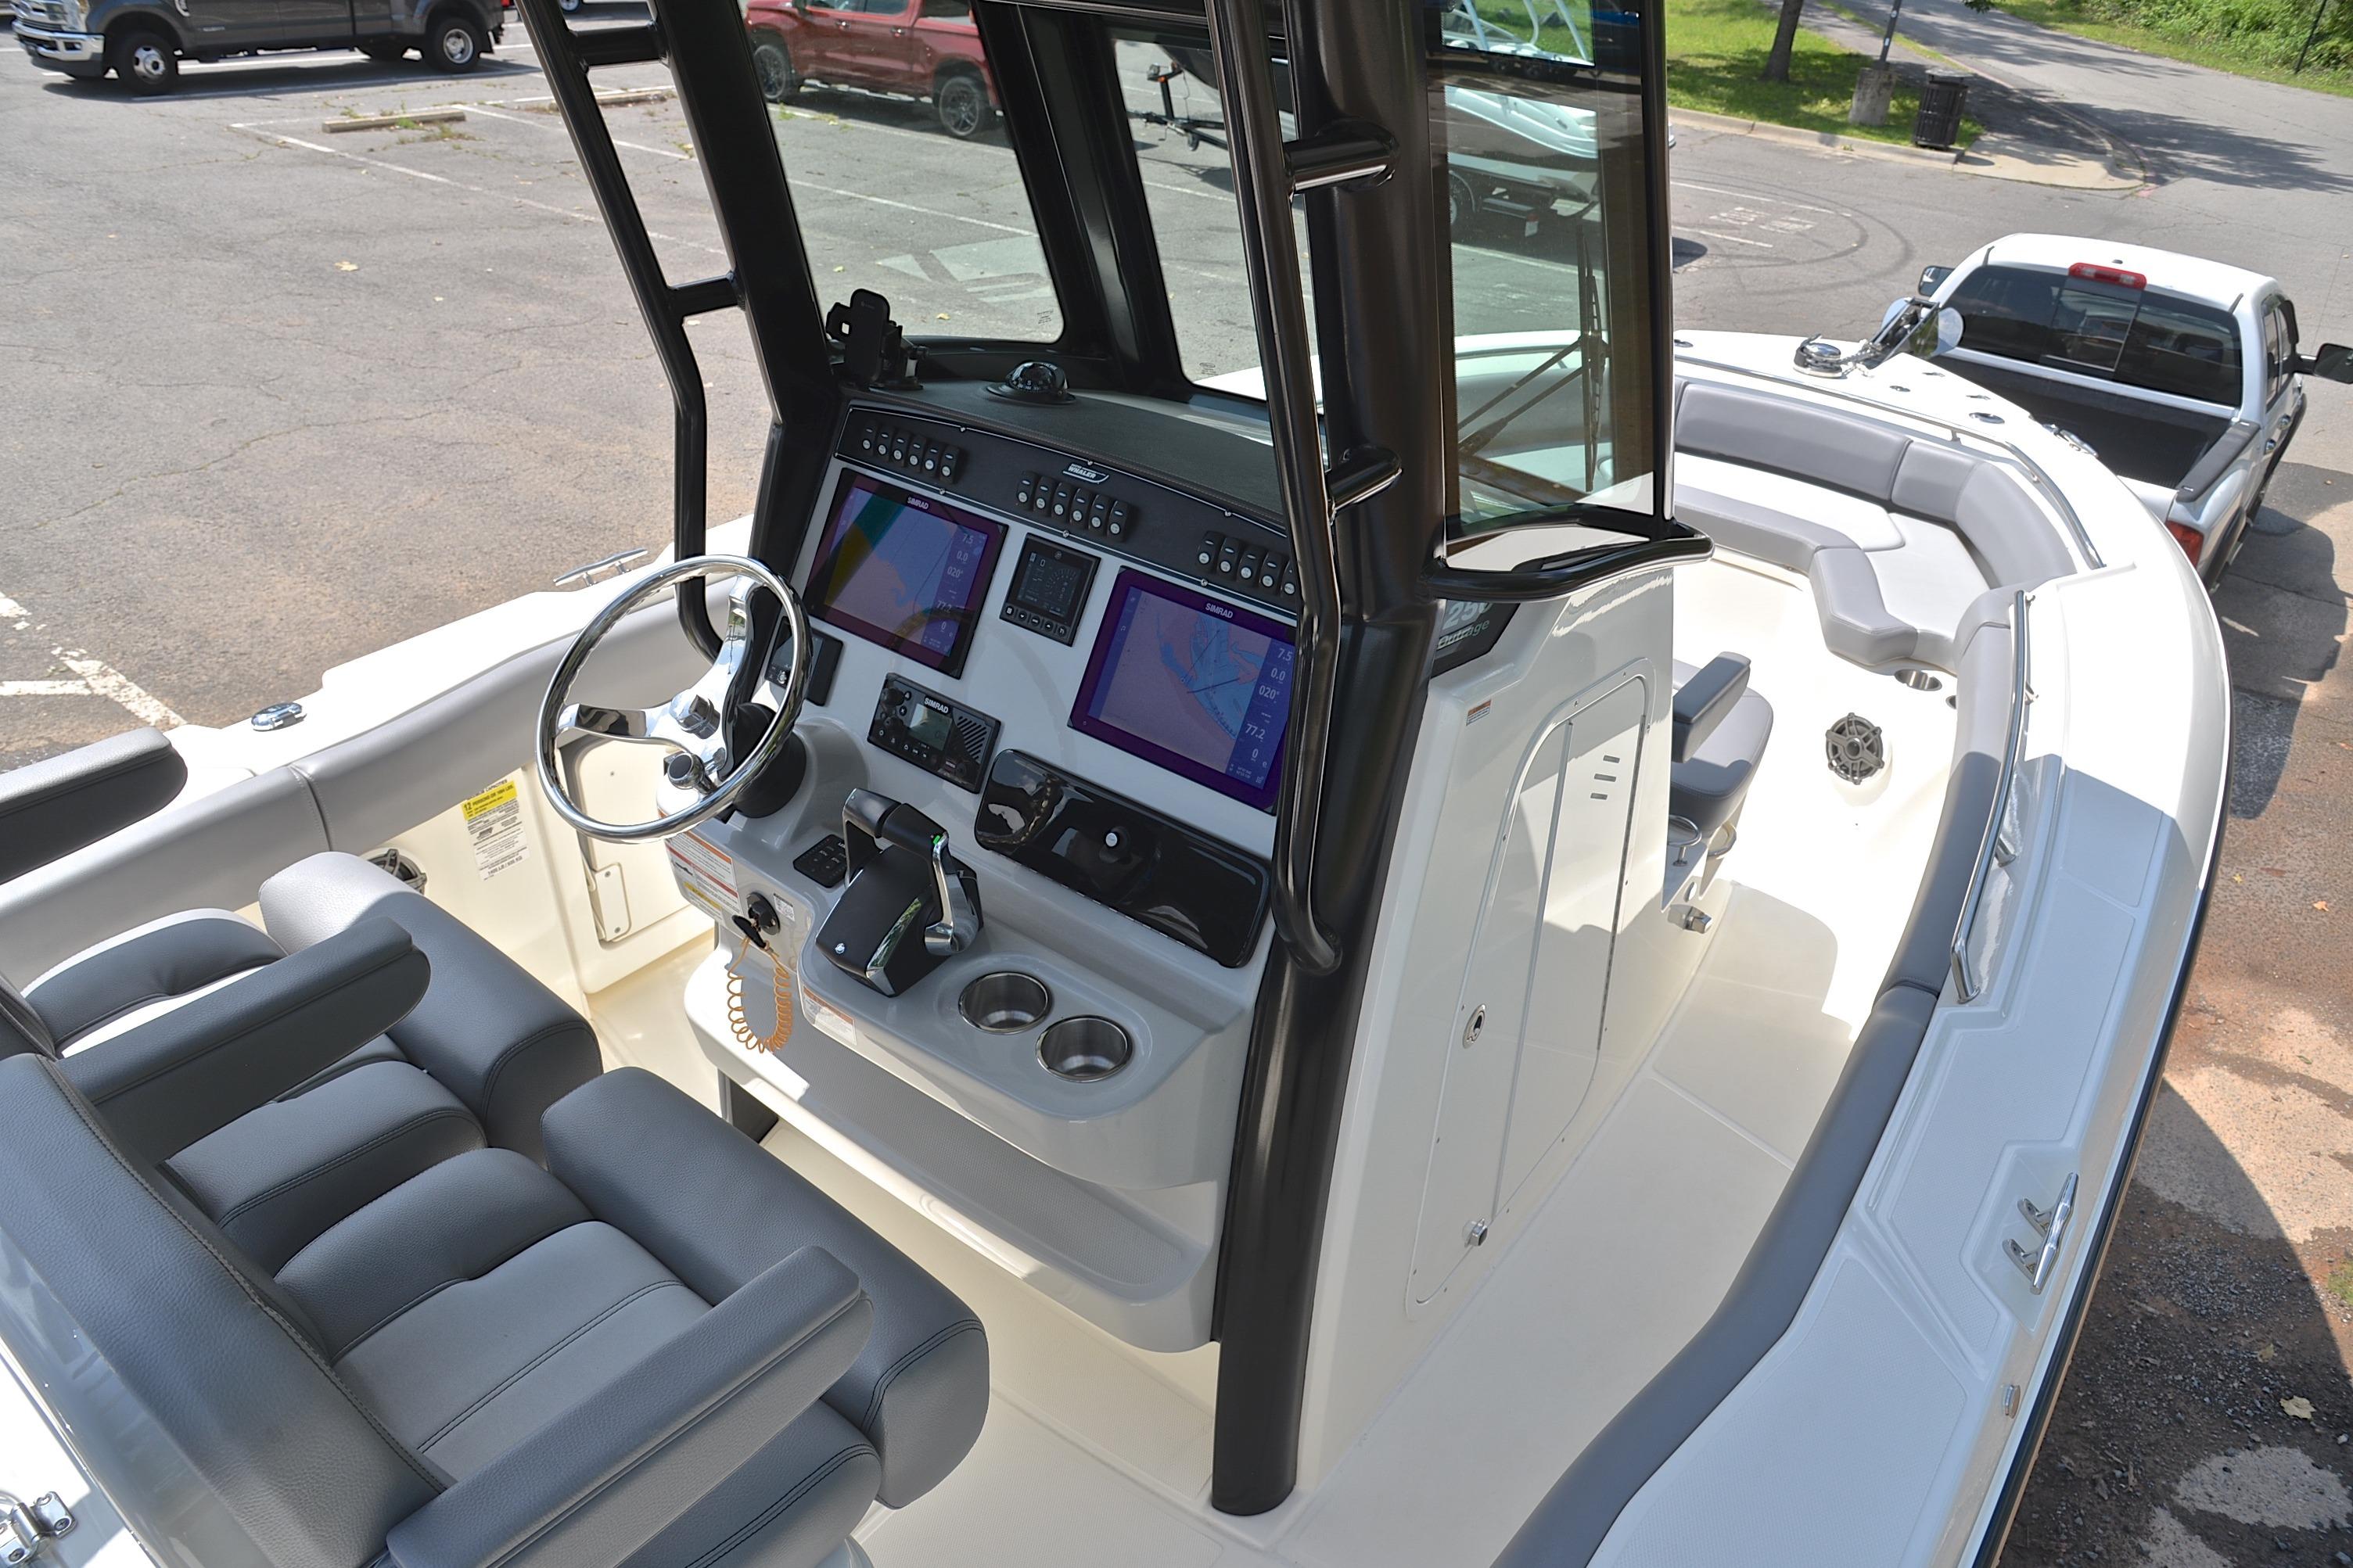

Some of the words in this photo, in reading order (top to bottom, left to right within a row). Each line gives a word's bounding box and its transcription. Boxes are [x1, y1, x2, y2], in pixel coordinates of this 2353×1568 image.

[1068, 465, 1097, 479] WHALER
[907, 497, 929, 510] SIMRAD
[962, 533, 974, 544] 7.5
[957, 551, 968, 562] 0.0
[1205, 603, 1234, 619] SIMRAD
[1437, 620, 1490, 651] Outrage
[1277, 648, 1293, 662] 7.5
[1270, 668, 1286, 681] 0.0
[924, 697, 949, 714] SIMRAD
[1245, 723, 1266, 740] 77.2
[1252, 748, 1259, 759] 0
[463, 802, 472, 812] 12
